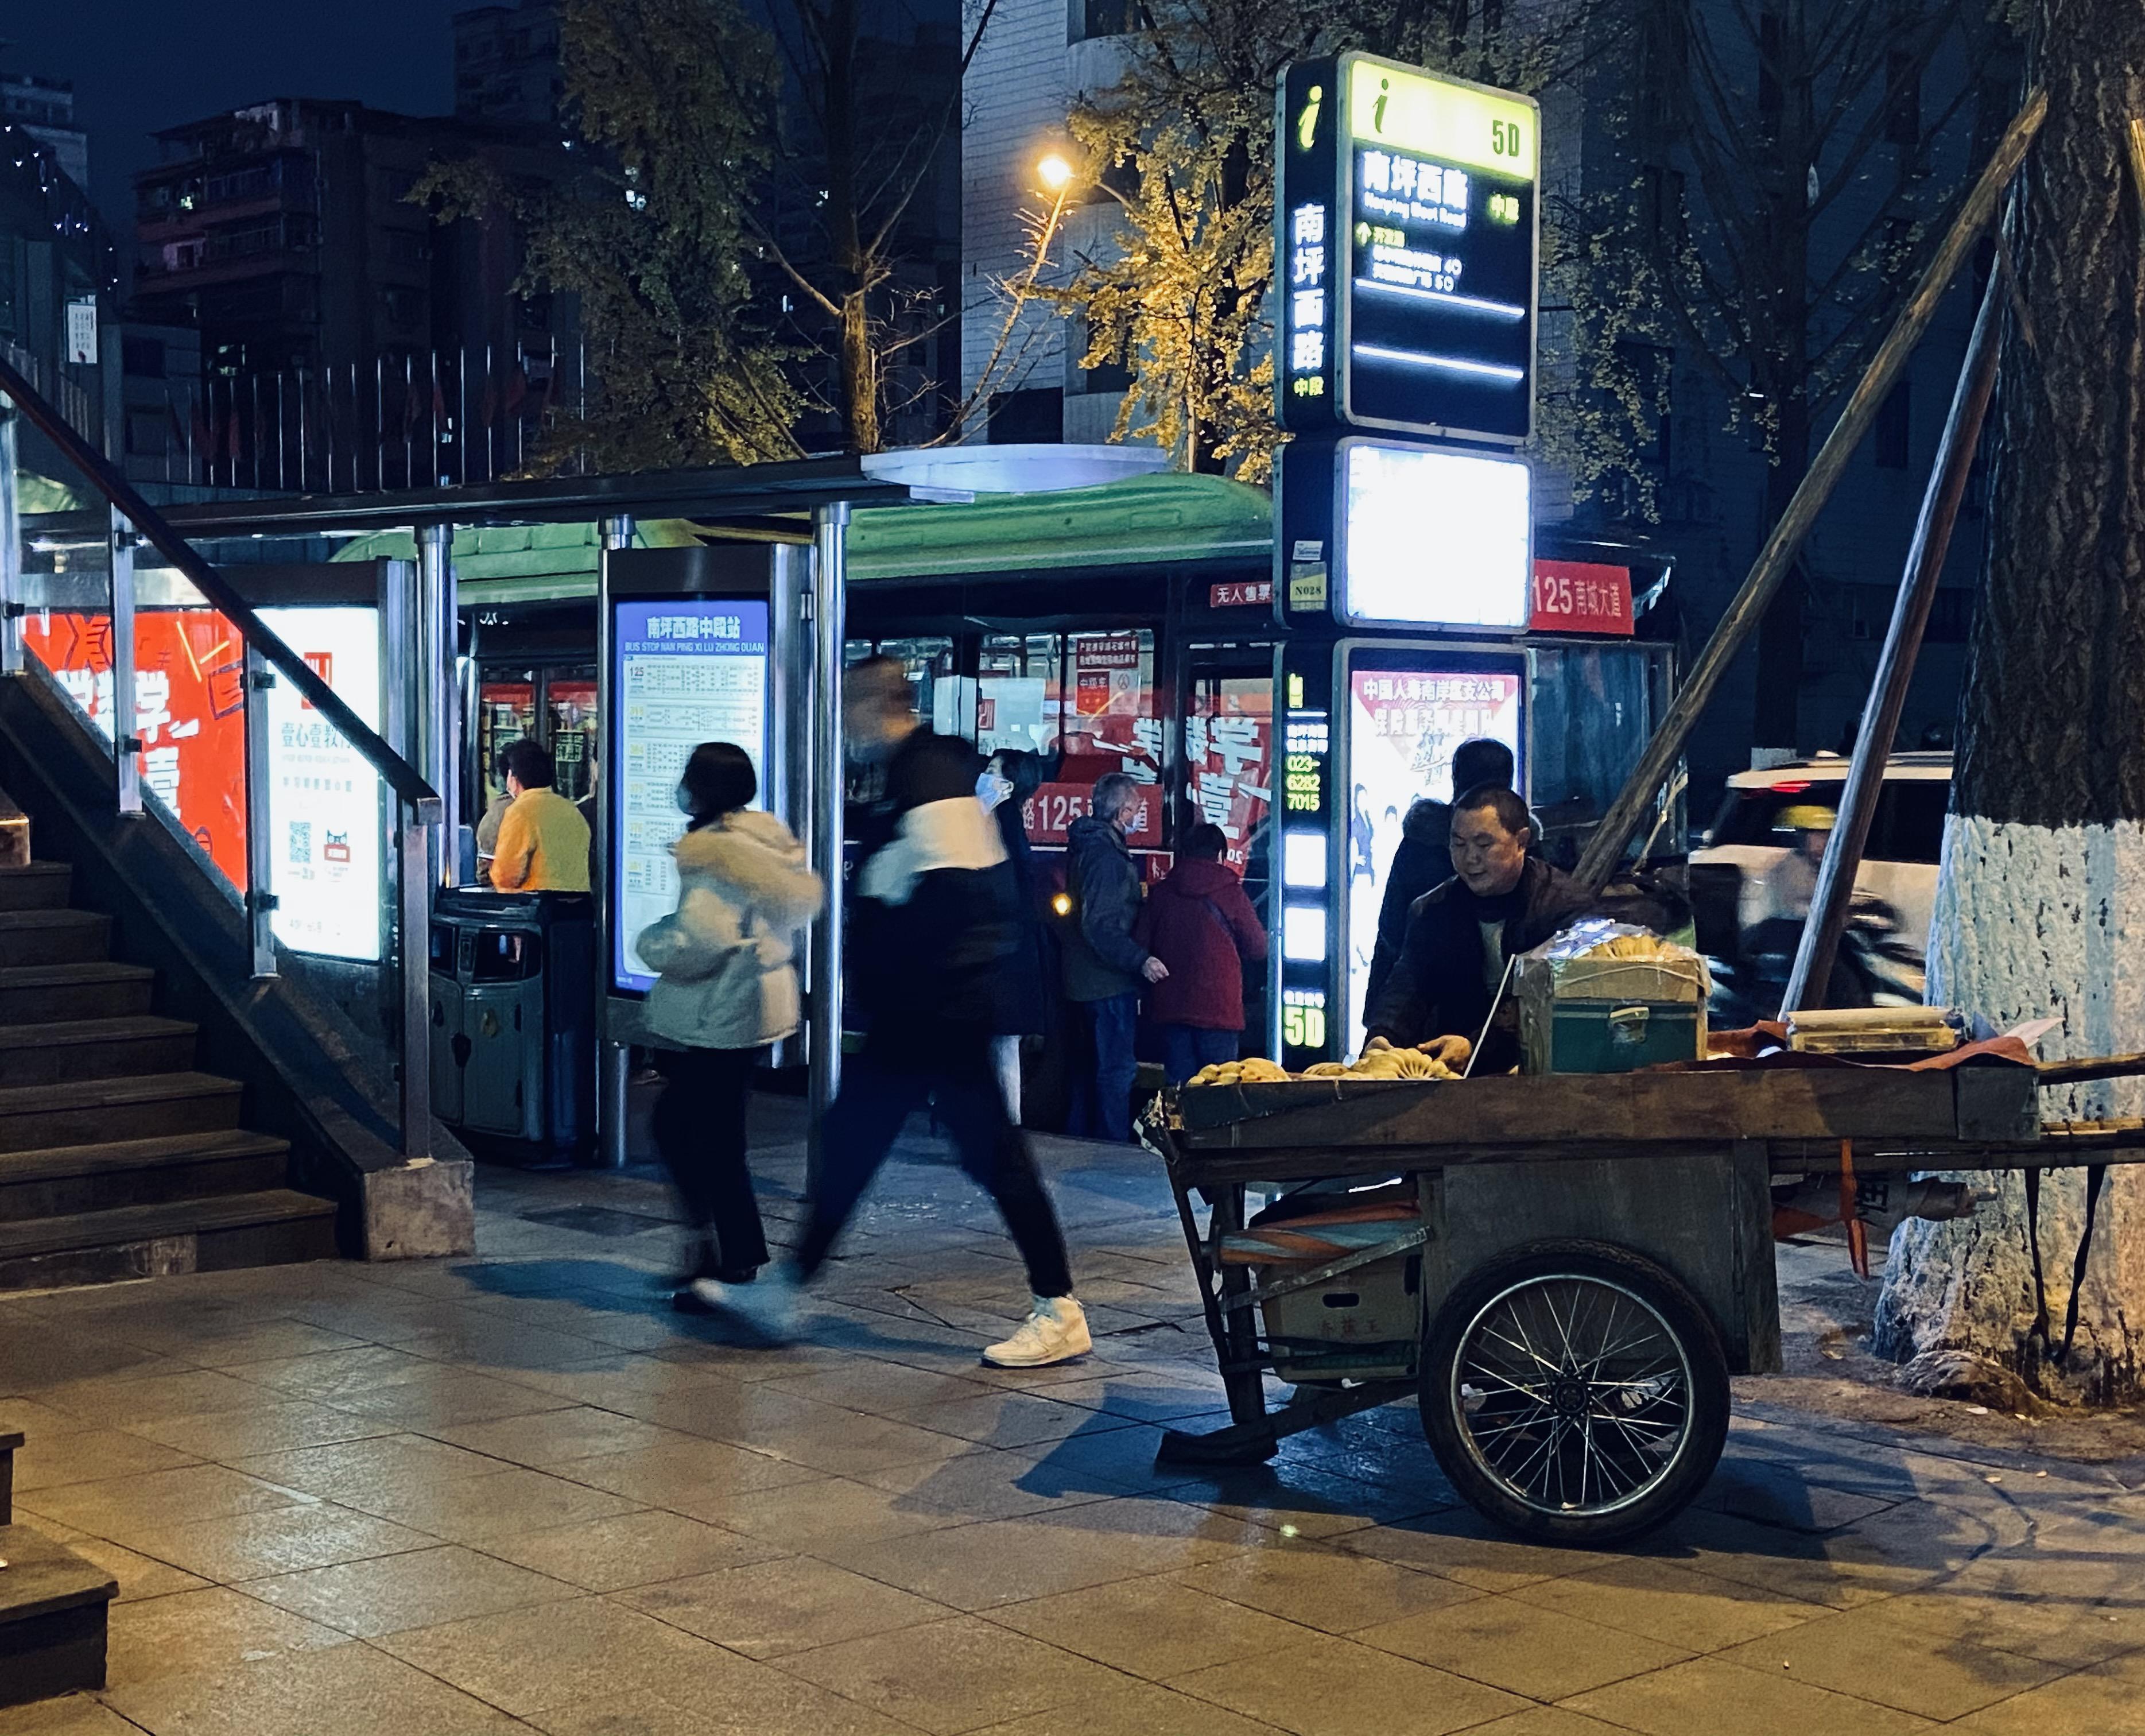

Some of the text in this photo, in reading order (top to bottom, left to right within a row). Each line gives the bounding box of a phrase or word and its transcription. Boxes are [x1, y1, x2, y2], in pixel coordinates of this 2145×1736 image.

[1293, 203, 1325, 371] 南坪西路
[1217, 584, 1271, 604] 无人售票
[1532, 575, 1573, 614] 125
[646, 616, 740, 640] 南坪西路中段站
[1038, 795, 1083, 831] 125
[1287, 792, 1321, 812] 7015
[1285, 1005, 1325, 1048] 5D
